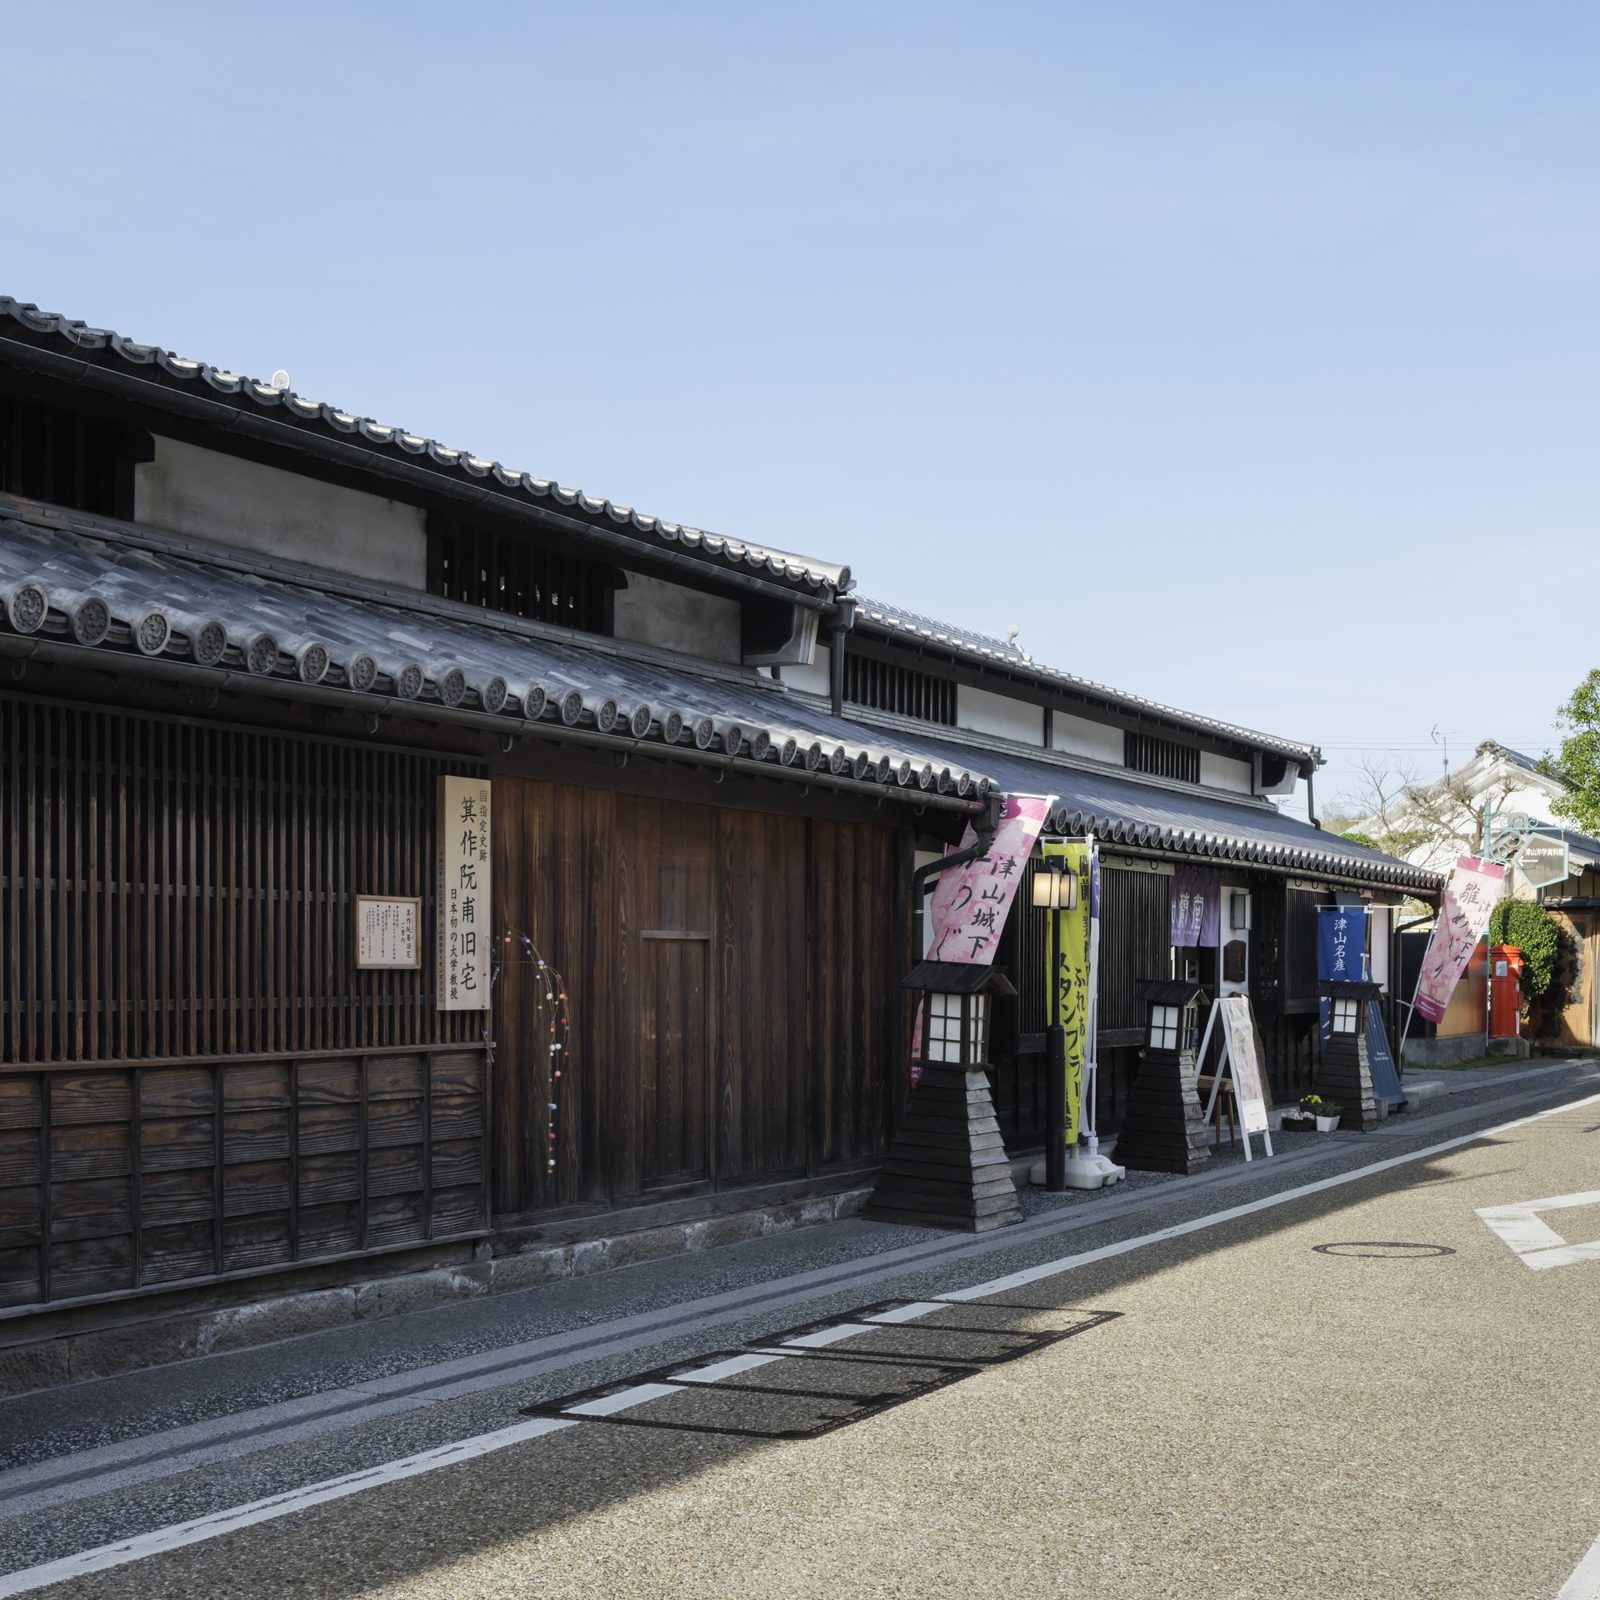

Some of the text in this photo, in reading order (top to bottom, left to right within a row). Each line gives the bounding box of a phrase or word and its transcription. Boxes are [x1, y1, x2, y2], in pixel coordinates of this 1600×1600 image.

[479, 790, 488, 862] 国指定史跡
[459, 796, 477, 991] 箕作阮甫旧宅
[449, 888, 458, 1000] 日本初の大学教授
[1333, 917, 1349, 972] 津山名産
